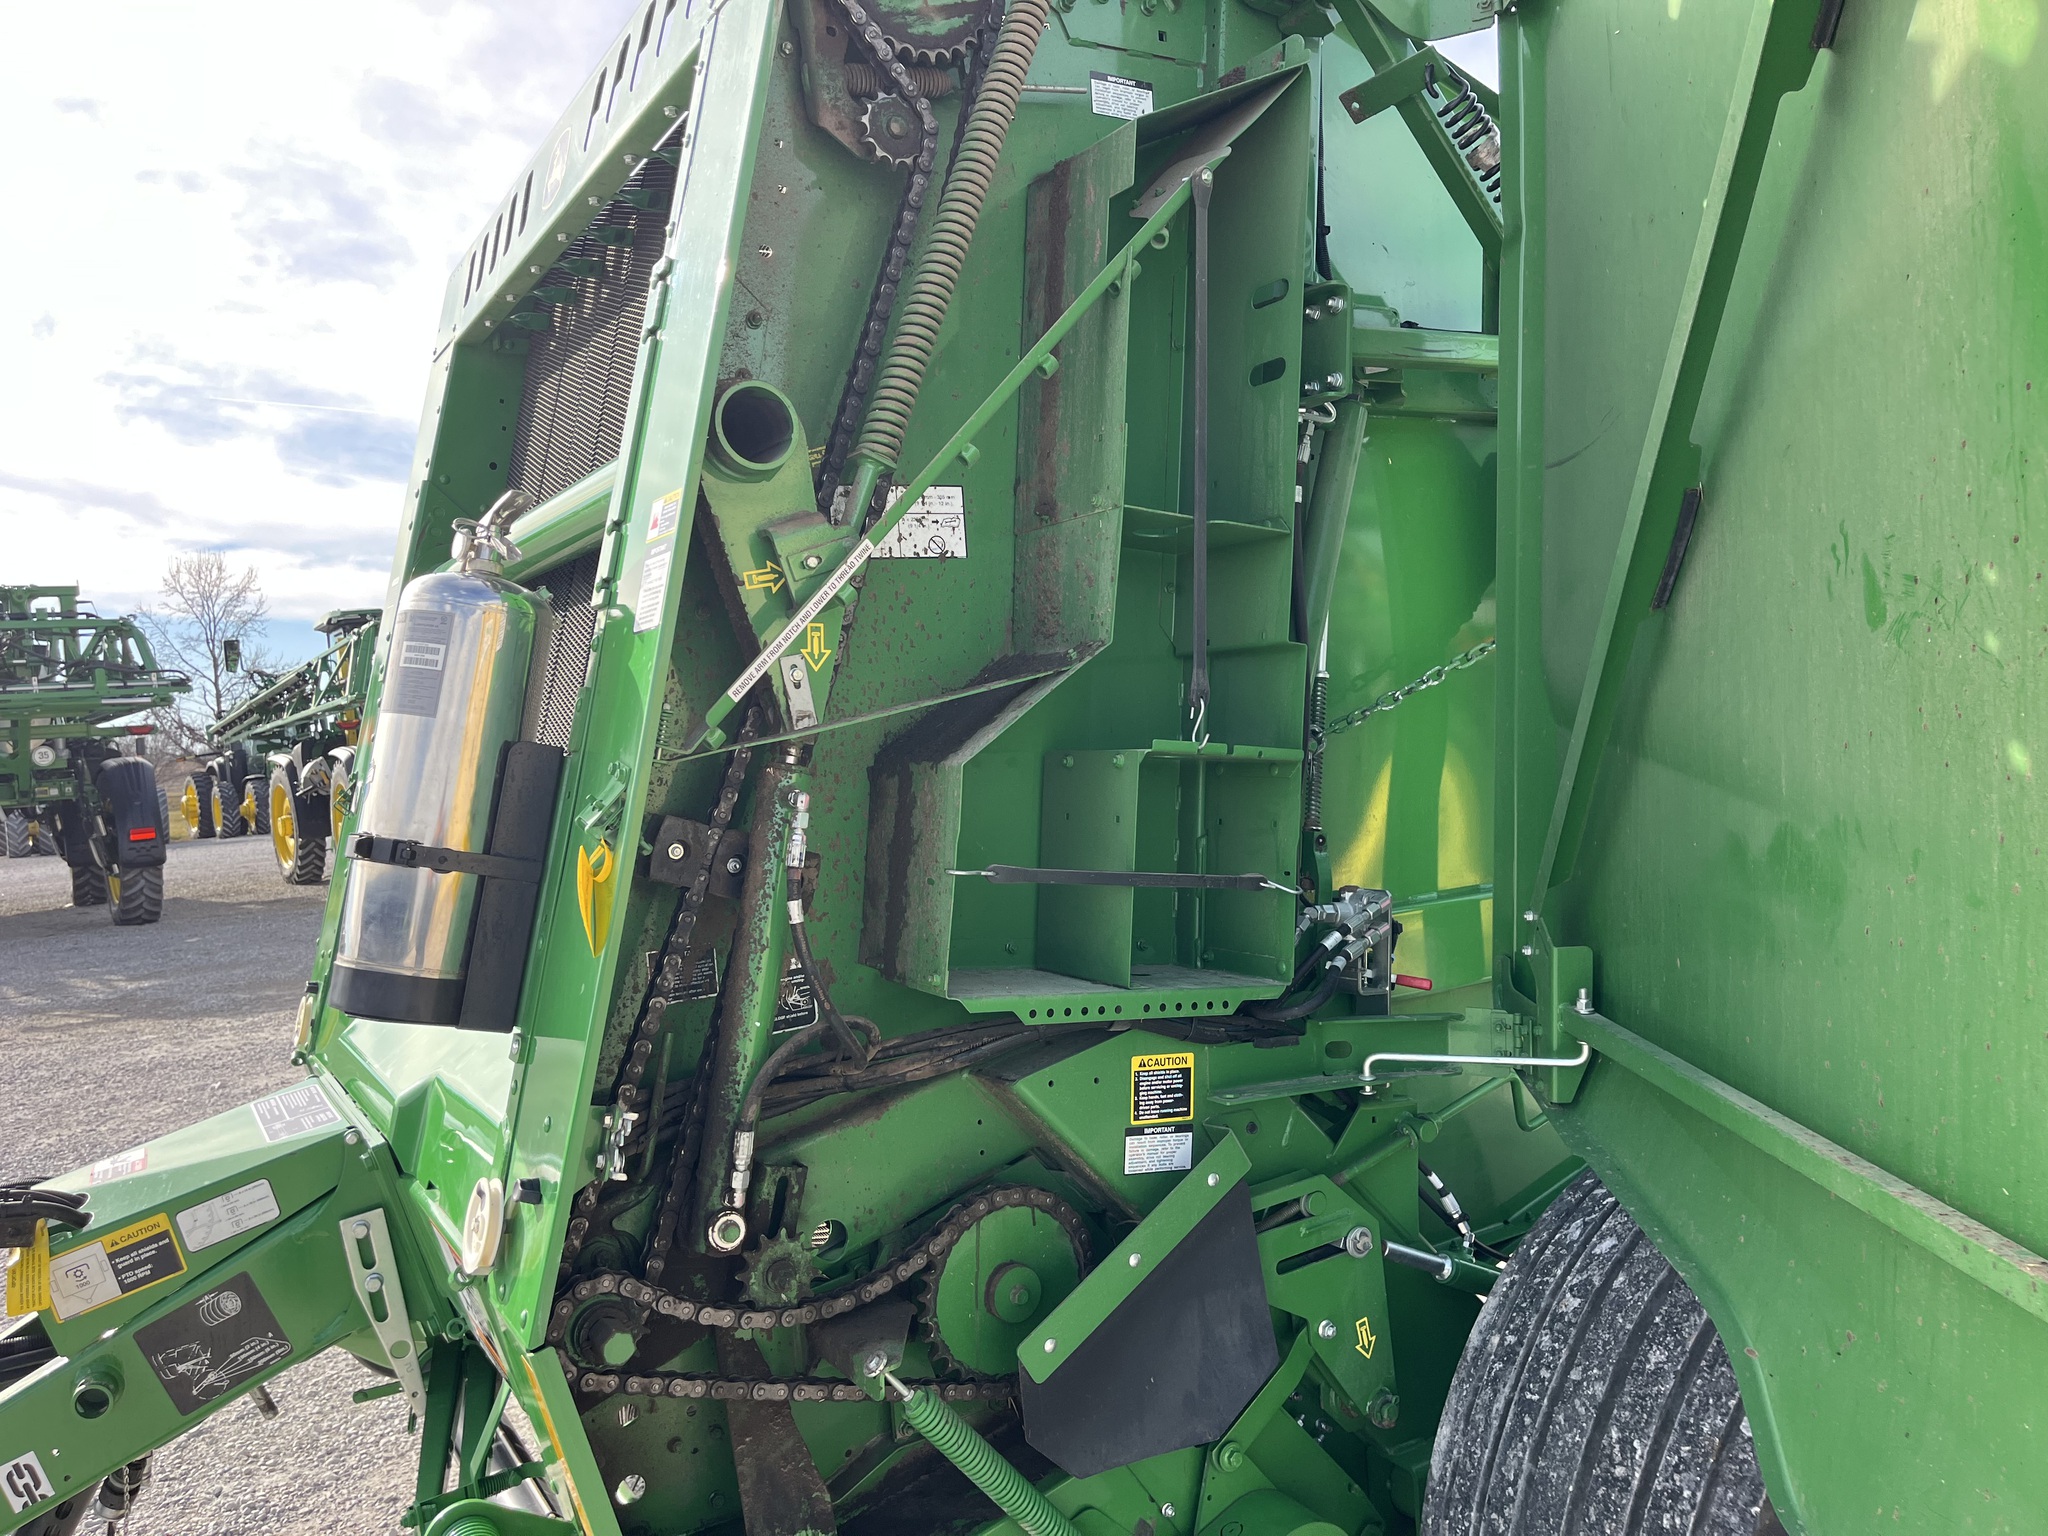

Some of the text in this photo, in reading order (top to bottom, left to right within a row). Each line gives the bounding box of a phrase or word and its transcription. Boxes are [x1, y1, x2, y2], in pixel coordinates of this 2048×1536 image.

[1107, 76, 1136, 86] IMPORTANT
[732, 544, 872, 698] REMOVE ARM FROM NOTCH AND LOWER TO THREAD TWINE
[38, 751, 49, 759] 35
[1147, 1056, 1187, 1067] CAUTION
[120, 1222, 160, 1243] CAUTION
[115, 1255, 130, 1263] Keep
[138, 1243, 158, 1254] shields
[159, 1238, 170, 1246] and
[117, 1258, 134, 1269] guard
[121, 1271, 133, 1280] PTO
[138, 1270, 151, 1278] RPM
